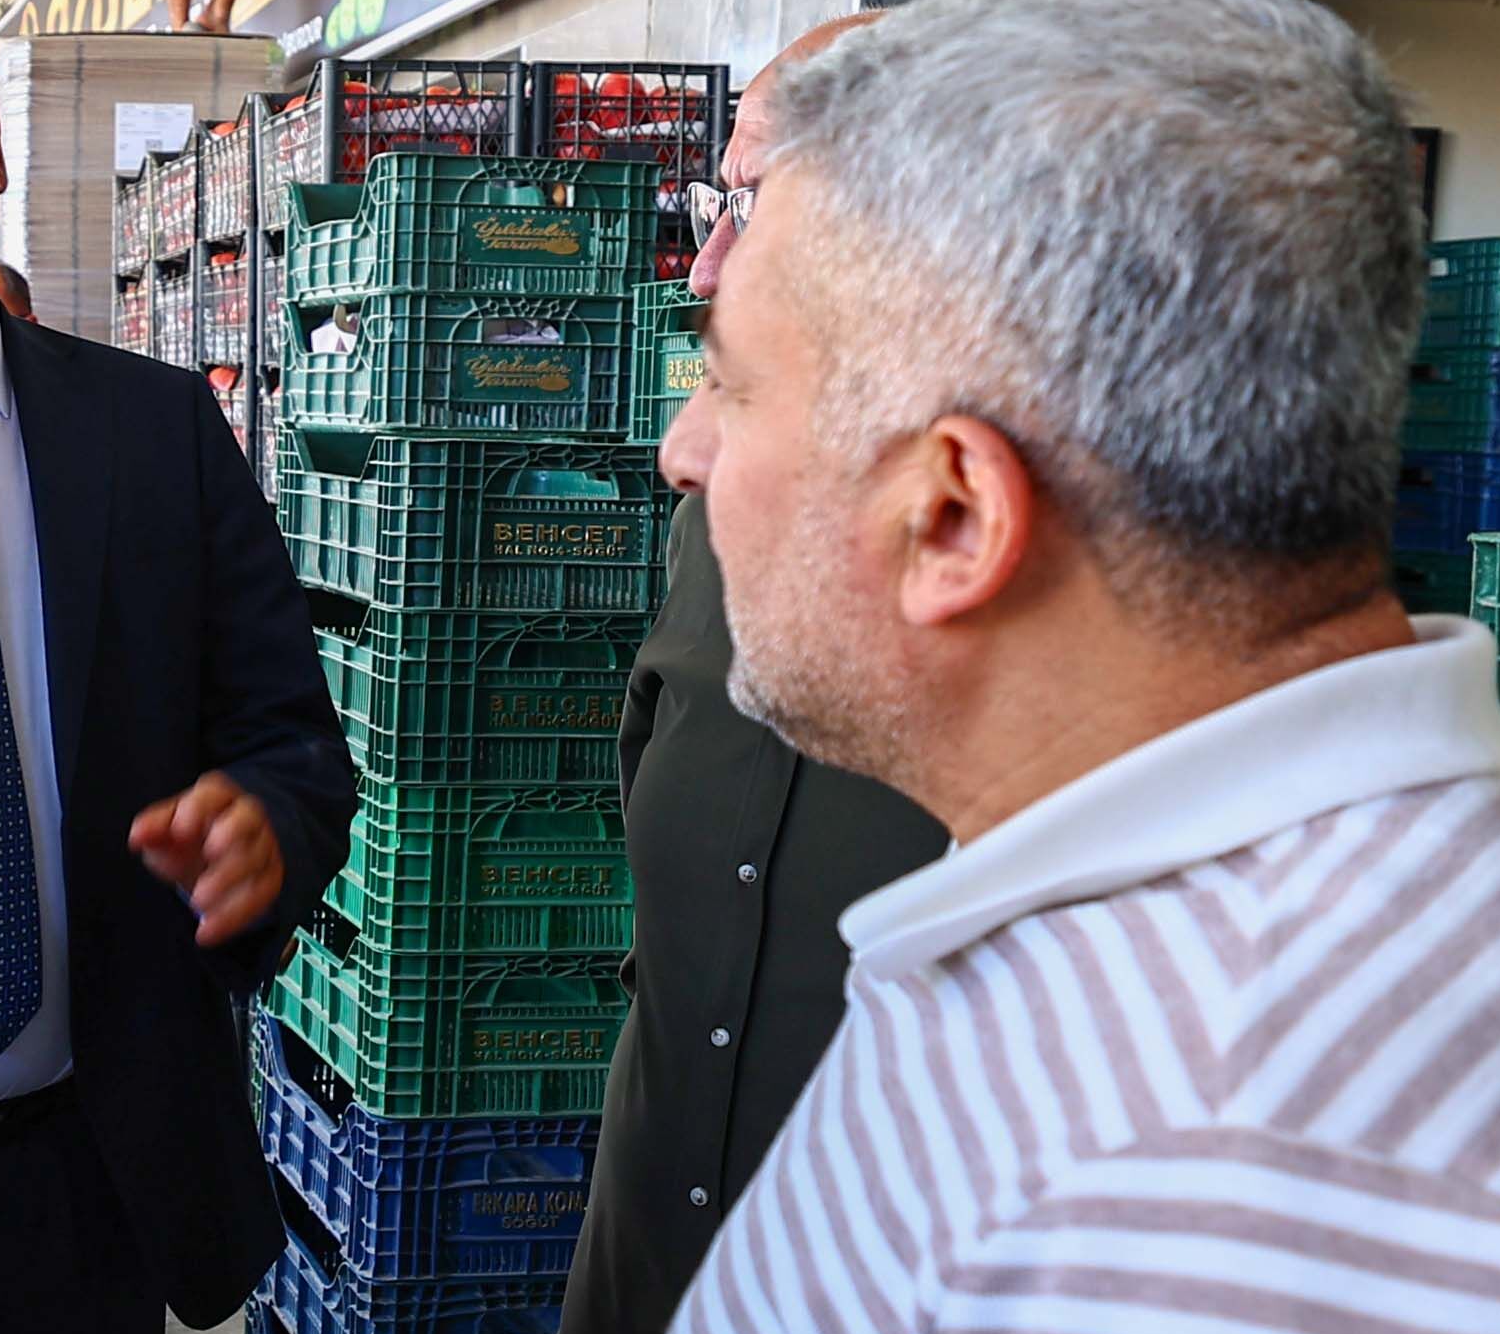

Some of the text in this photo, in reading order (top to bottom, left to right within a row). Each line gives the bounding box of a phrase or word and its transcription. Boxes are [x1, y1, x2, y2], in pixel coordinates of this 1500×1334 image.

[494, 523, 629, 544] BEHCET
[494, 544, 524, 556] HAL
[489, 695, 624, 713] BEHCET
[481, 865, 614, 884] BEHCET
[473, 1029, 607, 1048] BEHCET
